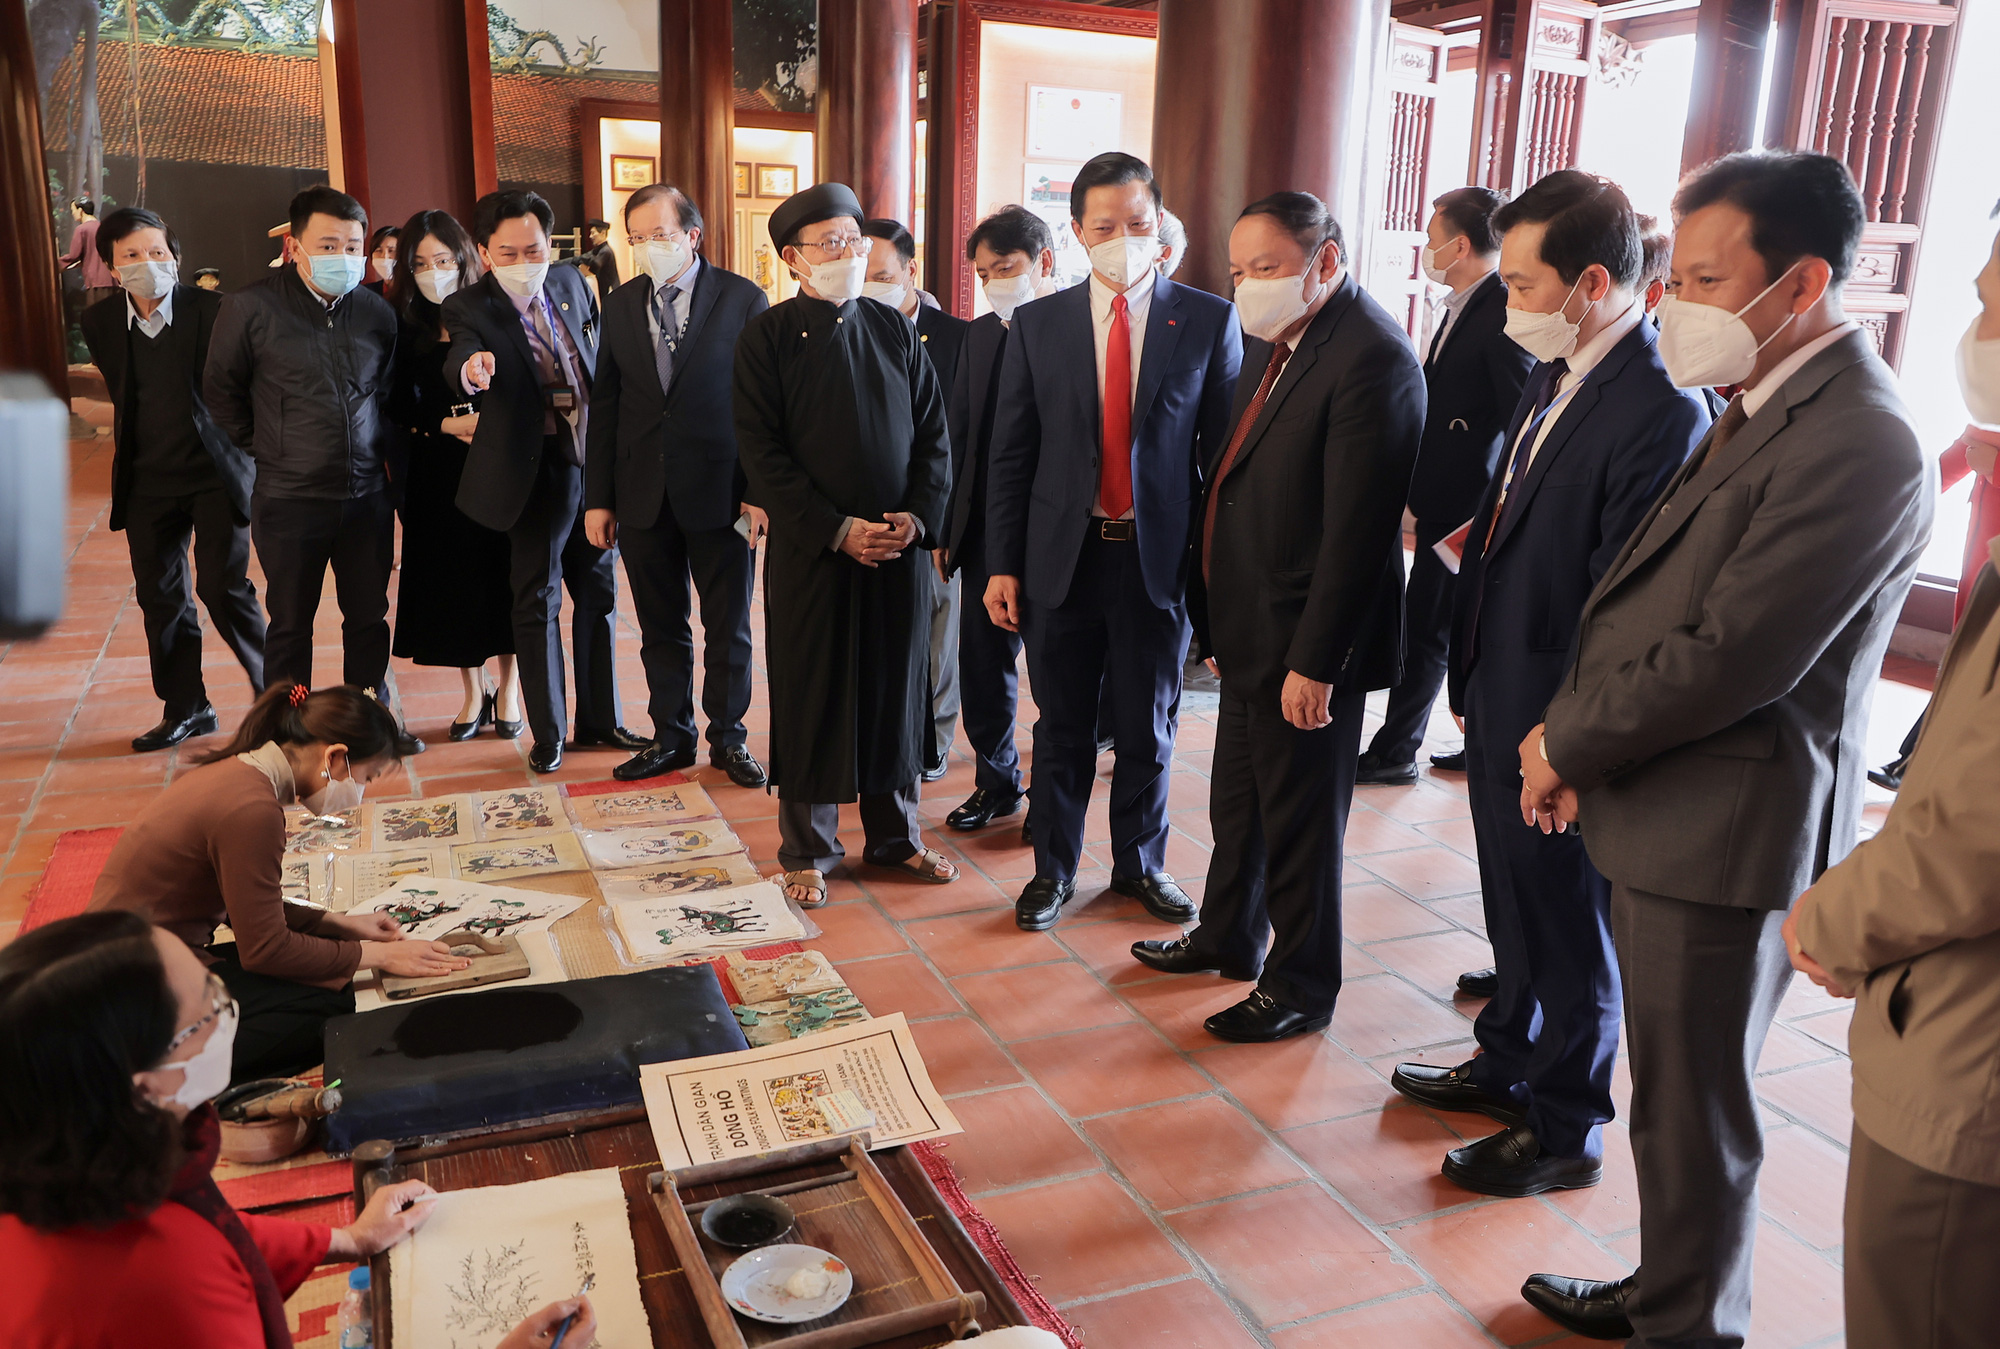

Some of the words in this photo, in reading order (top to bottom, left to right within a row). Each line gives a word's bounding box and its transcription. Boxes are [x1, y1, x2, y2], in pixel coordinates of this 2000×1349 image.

[690, 1082, 708, 1108] GIAN
[710, 1090, 736, 1111] HỒ
[737, 1079, 757, 1112] PAINTINGS
[697, 1111, 715, 1132] DÂN
[747, 1110, 762, 1126] FOLK
[704, 1132, 726, 1160] TRANH
